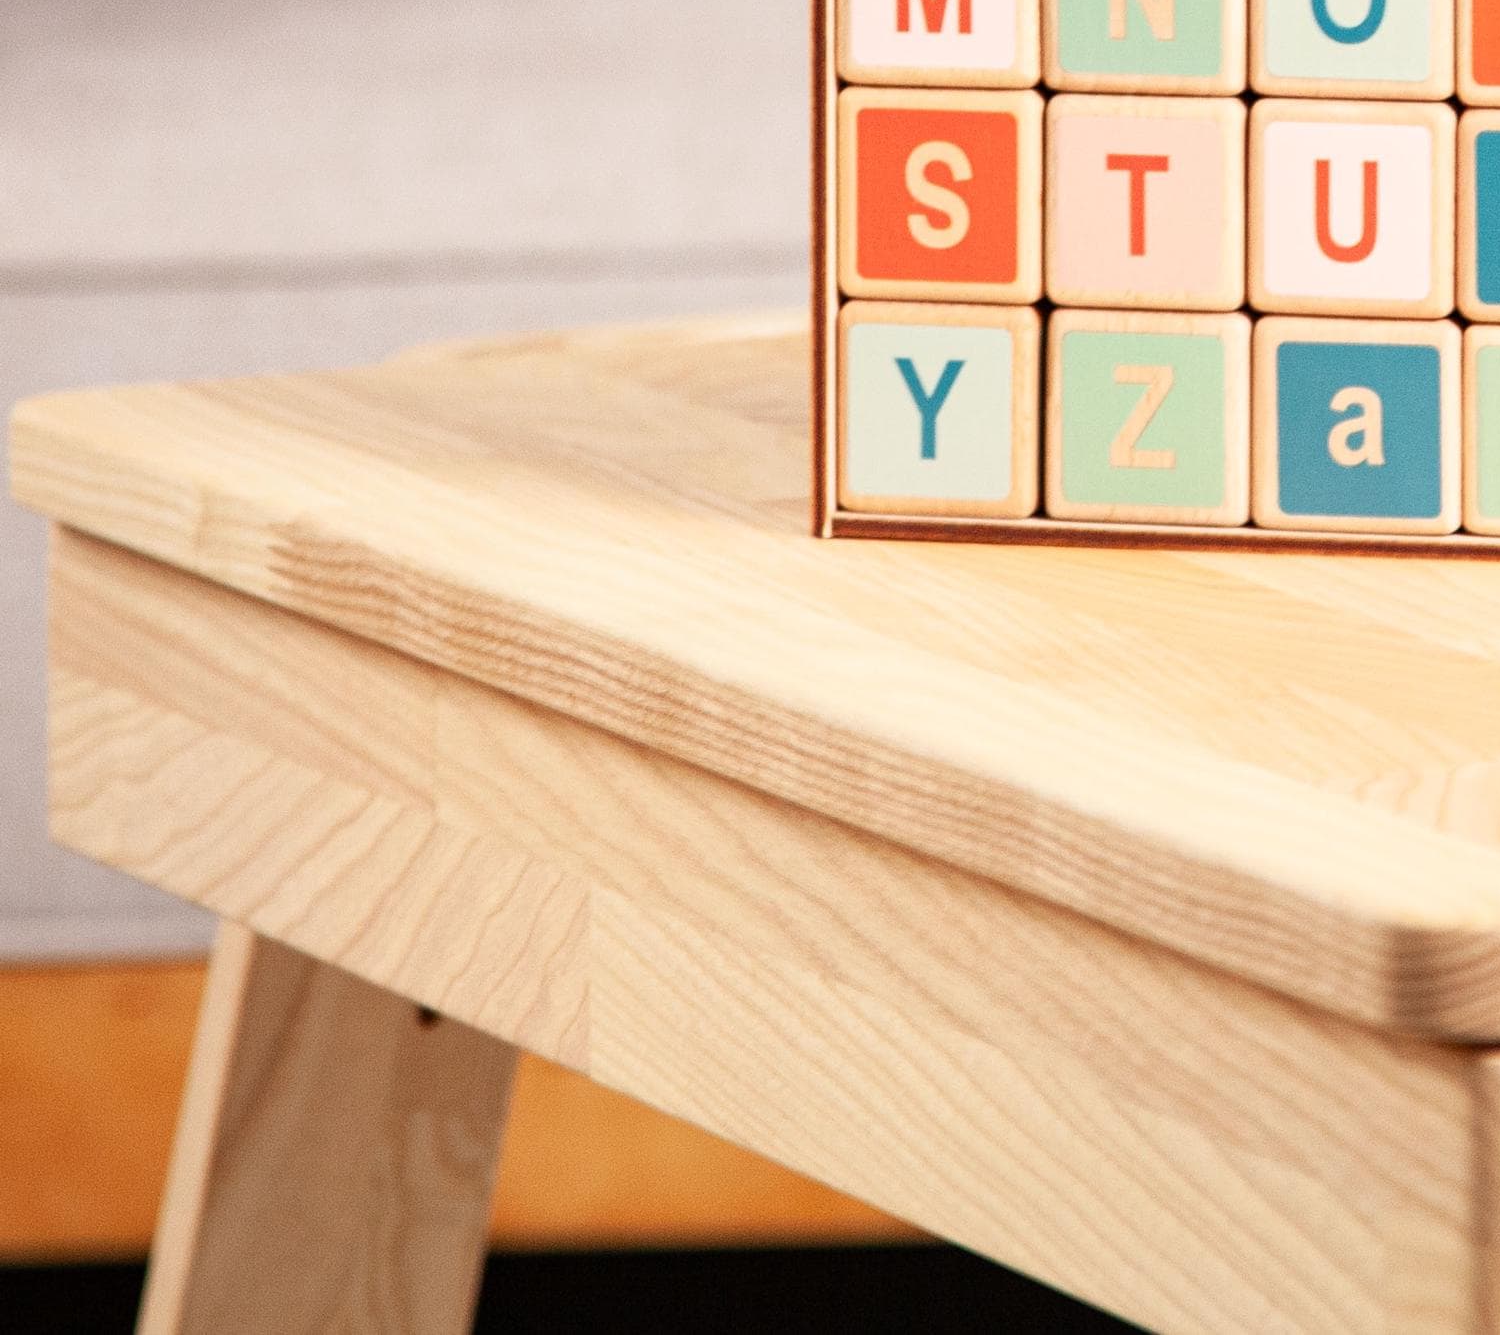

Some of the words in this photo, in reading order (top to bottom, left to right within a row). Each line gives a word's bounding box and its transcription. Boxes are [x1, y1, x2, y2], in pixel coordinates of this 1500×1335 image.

[904, 140, 973, 250] S
[1105, 153, 1170, 257] T
[1314, 159, 1378, 264] U
[894, 357, 965, 460] Y
[1108, 364, 1178, 471] Z
[1327, 386, 1385, 467] a
